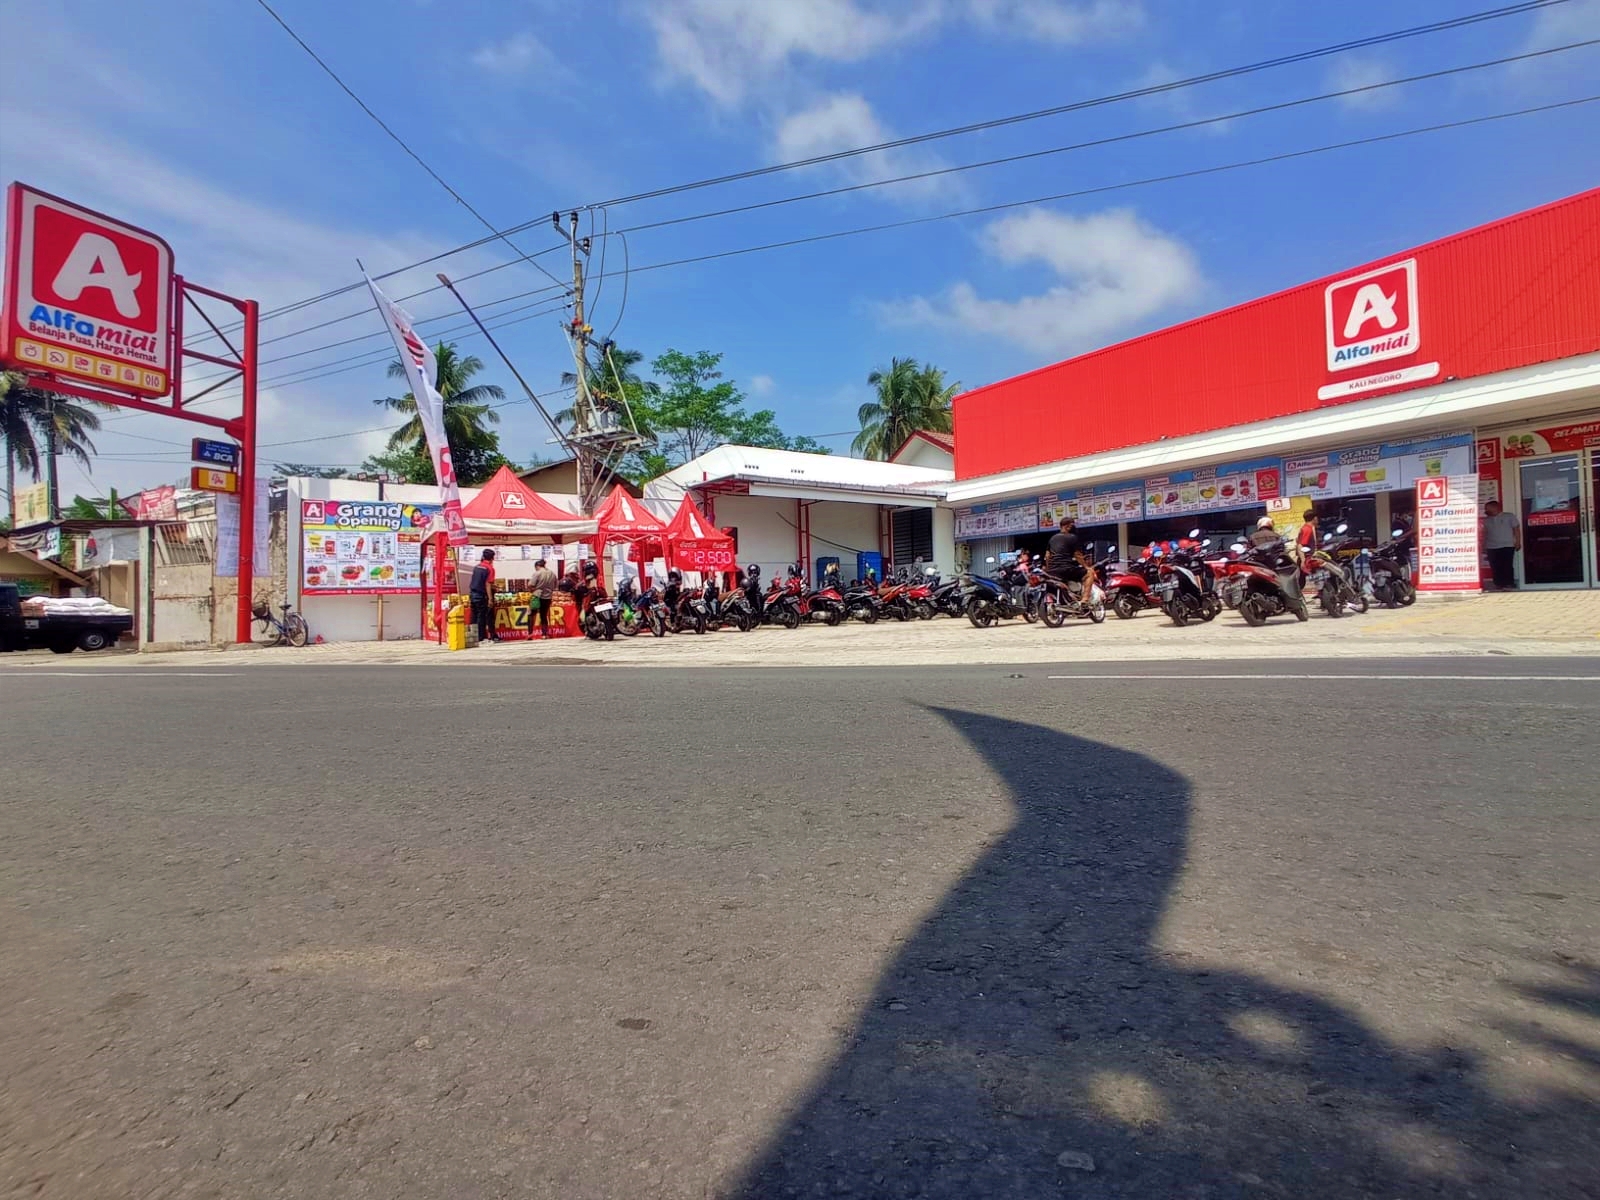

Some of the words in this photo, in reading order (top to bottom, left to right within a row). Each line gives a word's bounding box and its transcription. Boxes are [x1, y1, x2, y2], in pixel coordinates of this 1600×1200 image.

[29, 304, 158, 353] Alfamidi
[29, 321, 66, 340] Belanja
[69, 332, 95, 348] Puas,
[96, 340, 125, 355] Harga
[126, 348, 158, 363] Hemat
[1334, 333, 1410, 362] Alfamidi
[1349, 380, 1367, 390] KALI
[1368, 373, 1402, 386] NEGORO
[213, 452, 233, 462] BCA
[1339, 447, 1380, 460] Grand
[336, 503, 402, 517] Grand
[1434, 508, 1475, 517] Alfamidi
[338, 516, 401, 530] Opening
[1434, 527, 1475, 536] Alfamidi
[1434, 546, 1476, 554] Alfamidi
[1434, 565, 1476, 573] Alfamidi
